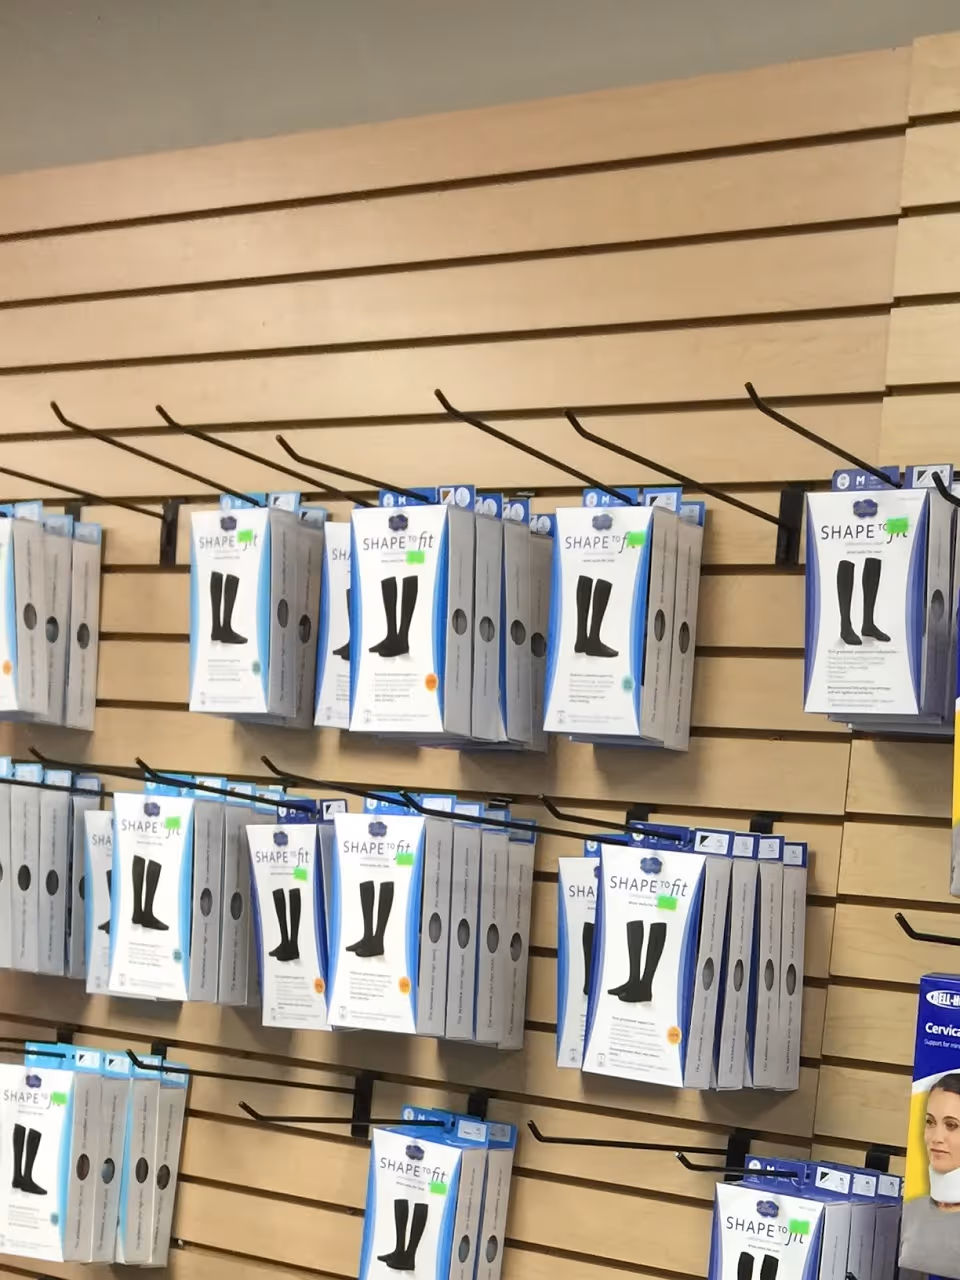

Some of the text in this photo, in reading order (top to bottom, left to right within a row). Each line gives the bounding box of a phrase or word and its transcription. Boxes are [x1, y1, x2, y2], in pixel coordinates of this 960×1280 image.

[856, 475, 866, 485] M
[199, 536, 235, 550] SHAPE
[362, 533, 406, 551] SHAPE
[418, 531, 435, 552] fit
[565, 535, 609, 550] SHAPE
[121, 818, 158, 834] SHAPE
[609, 875, 658, 894] SHAPE
[670, 878, 689, 897] fit
[380, 1157, 420, 1178] SHAPE
[422, 1167, 431, 1175] TO
[726, 1216, 788, 1238] SHAPE TO
